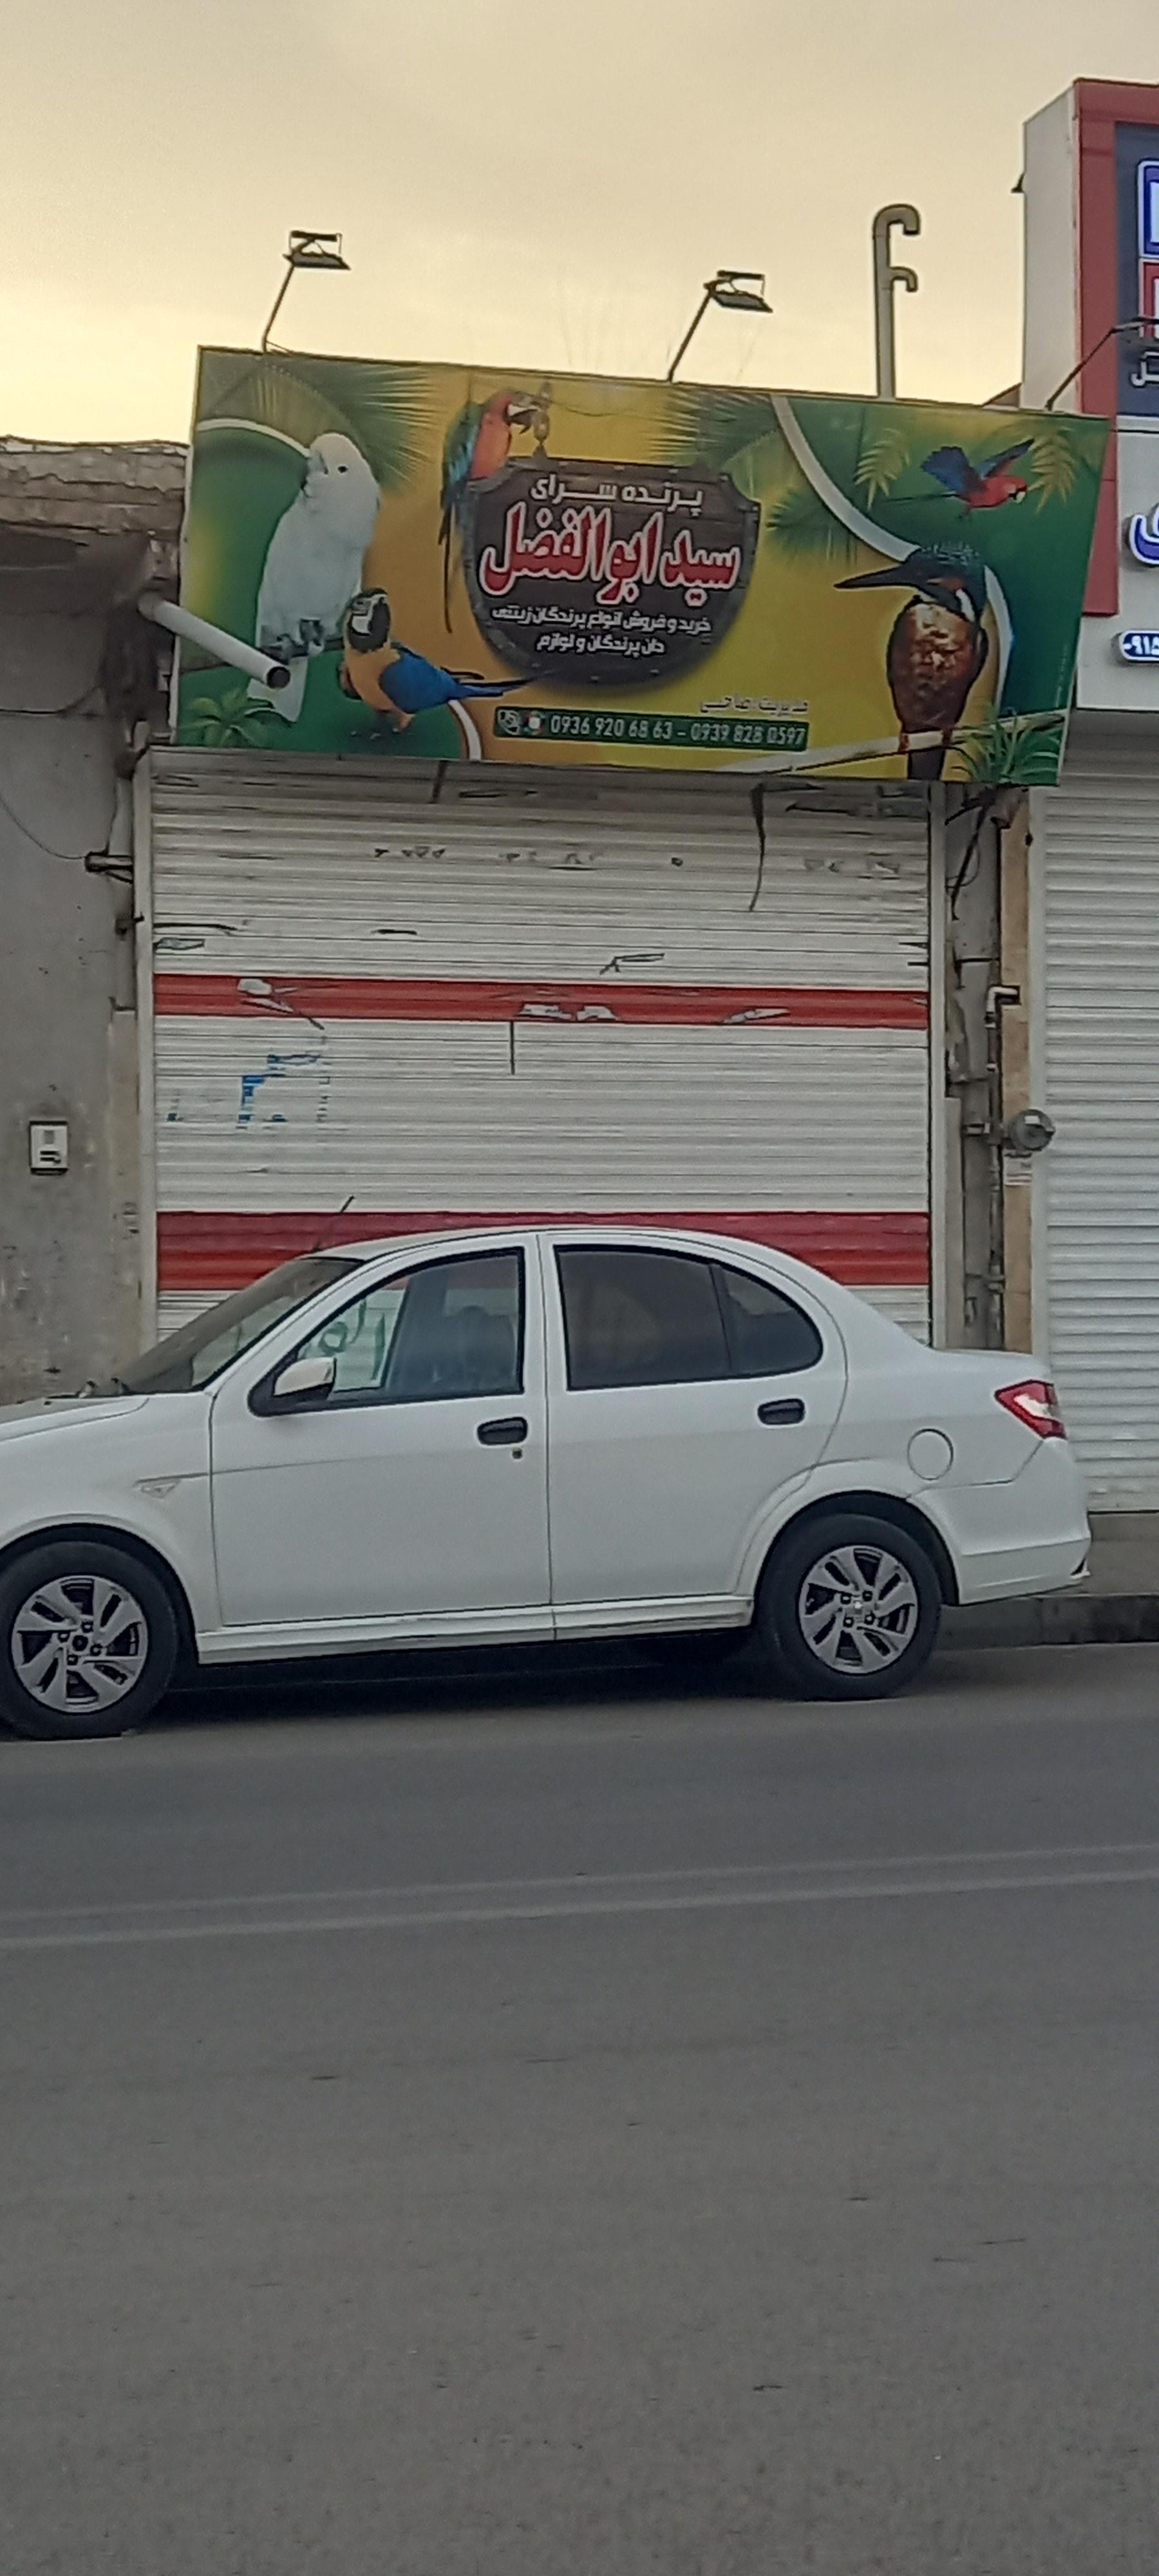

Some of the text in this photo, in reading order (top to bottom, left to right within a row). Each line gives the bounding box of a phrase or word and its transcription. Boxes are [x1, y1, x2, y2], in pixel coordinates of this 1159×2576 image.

[531, 473, 703, 516] پرنده سرای
[660, 529, 741, 607] سید
[492, 605, 532, 624] زینتی
[533, 606, 587, 629] پرندگان
[623, 611, 666, 632] فروش
[667, 618, 677, 634] و
[677, 617, 711, 636] خرید
[536, 632, 665, 658] دان پرندگان و لوازم
[551, 715, 590, 735] 0936
[595, 717, 625, 737] 920
[628, 720, 648, 739] 68
[652, 721, 674, 740] 63
[690, 723, 730, 741] 0939
[733, 724, 765, 744] 828
[767, 726, 806, 745] 0597
